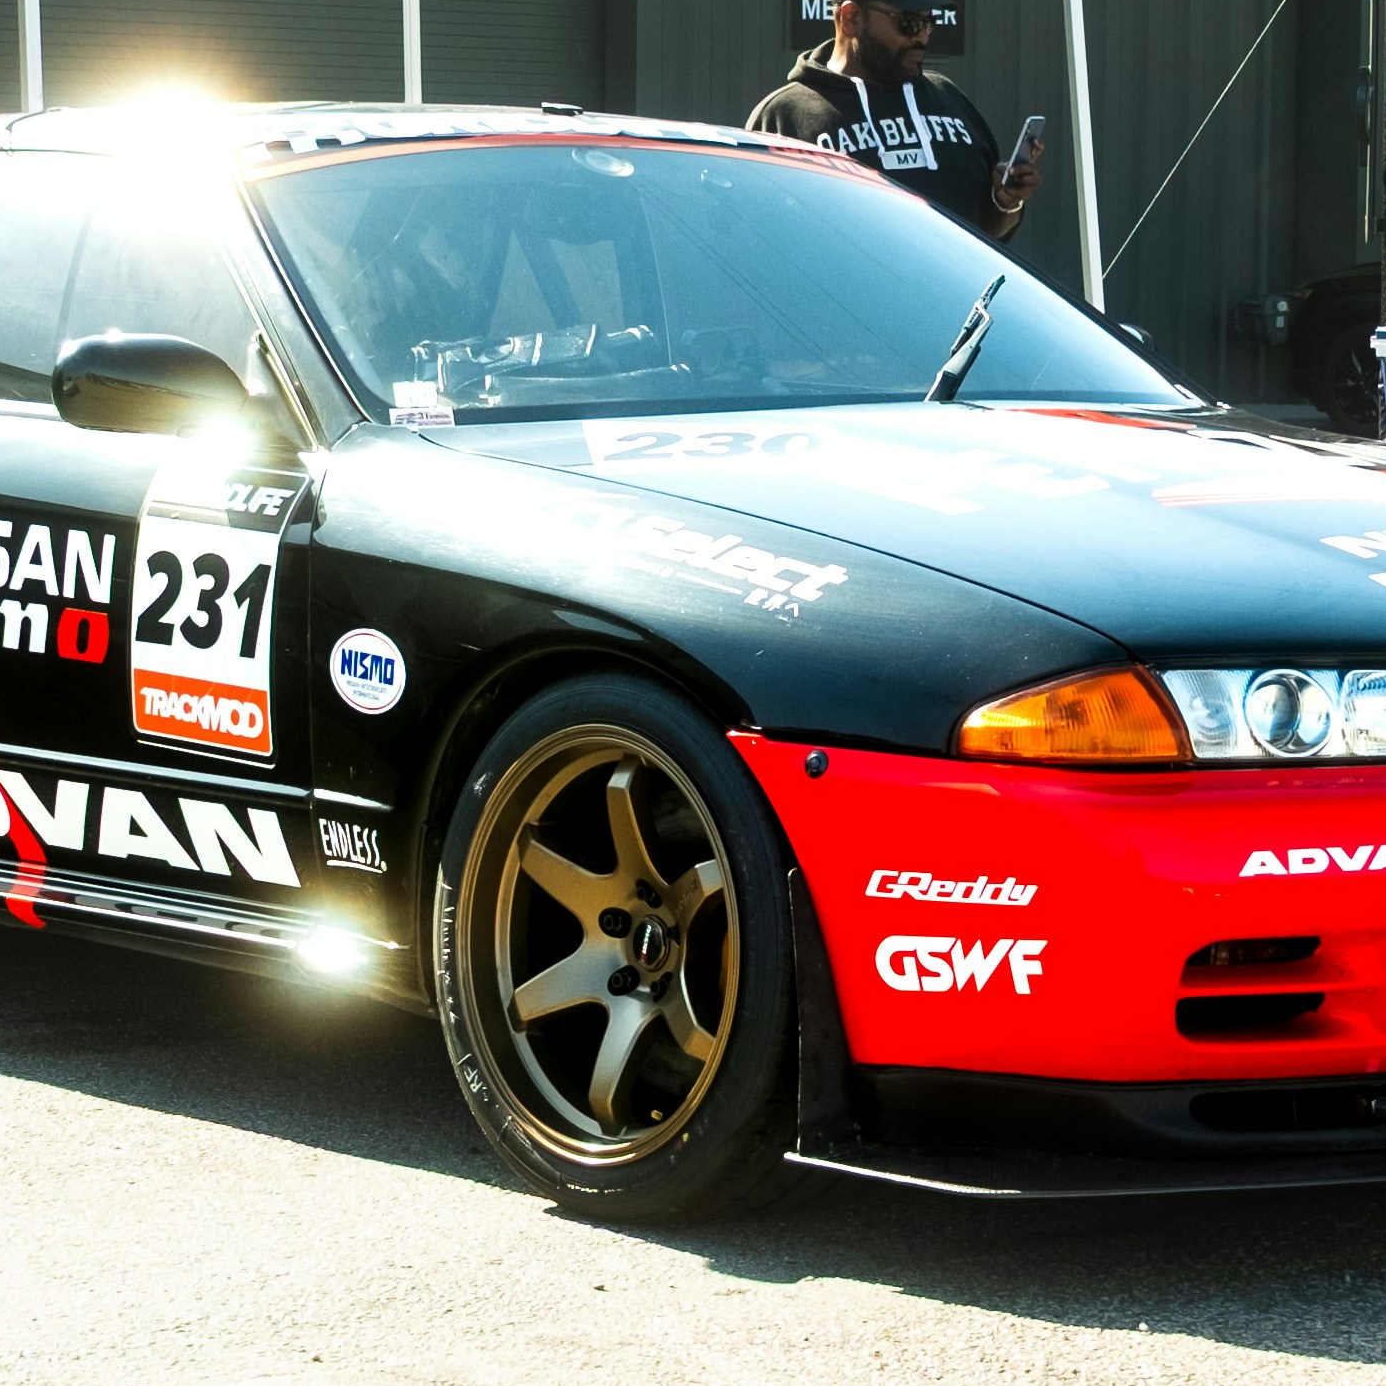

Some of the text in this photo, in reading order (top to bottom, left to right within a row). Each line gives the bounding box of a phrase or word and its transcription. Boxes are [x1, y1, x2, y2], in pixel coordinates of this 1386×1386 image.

[816, 119, 880, 154] OAK
[895, 152, 919, 166] MV
[134, 549, 272, 660] 231
[340, 648, 396, 686] NISMO
[140, 686, 264, 740] TRACKMOD
[865, 868, 1039, 907] GReddy
[875, 934, 1049, 996] GSWF
